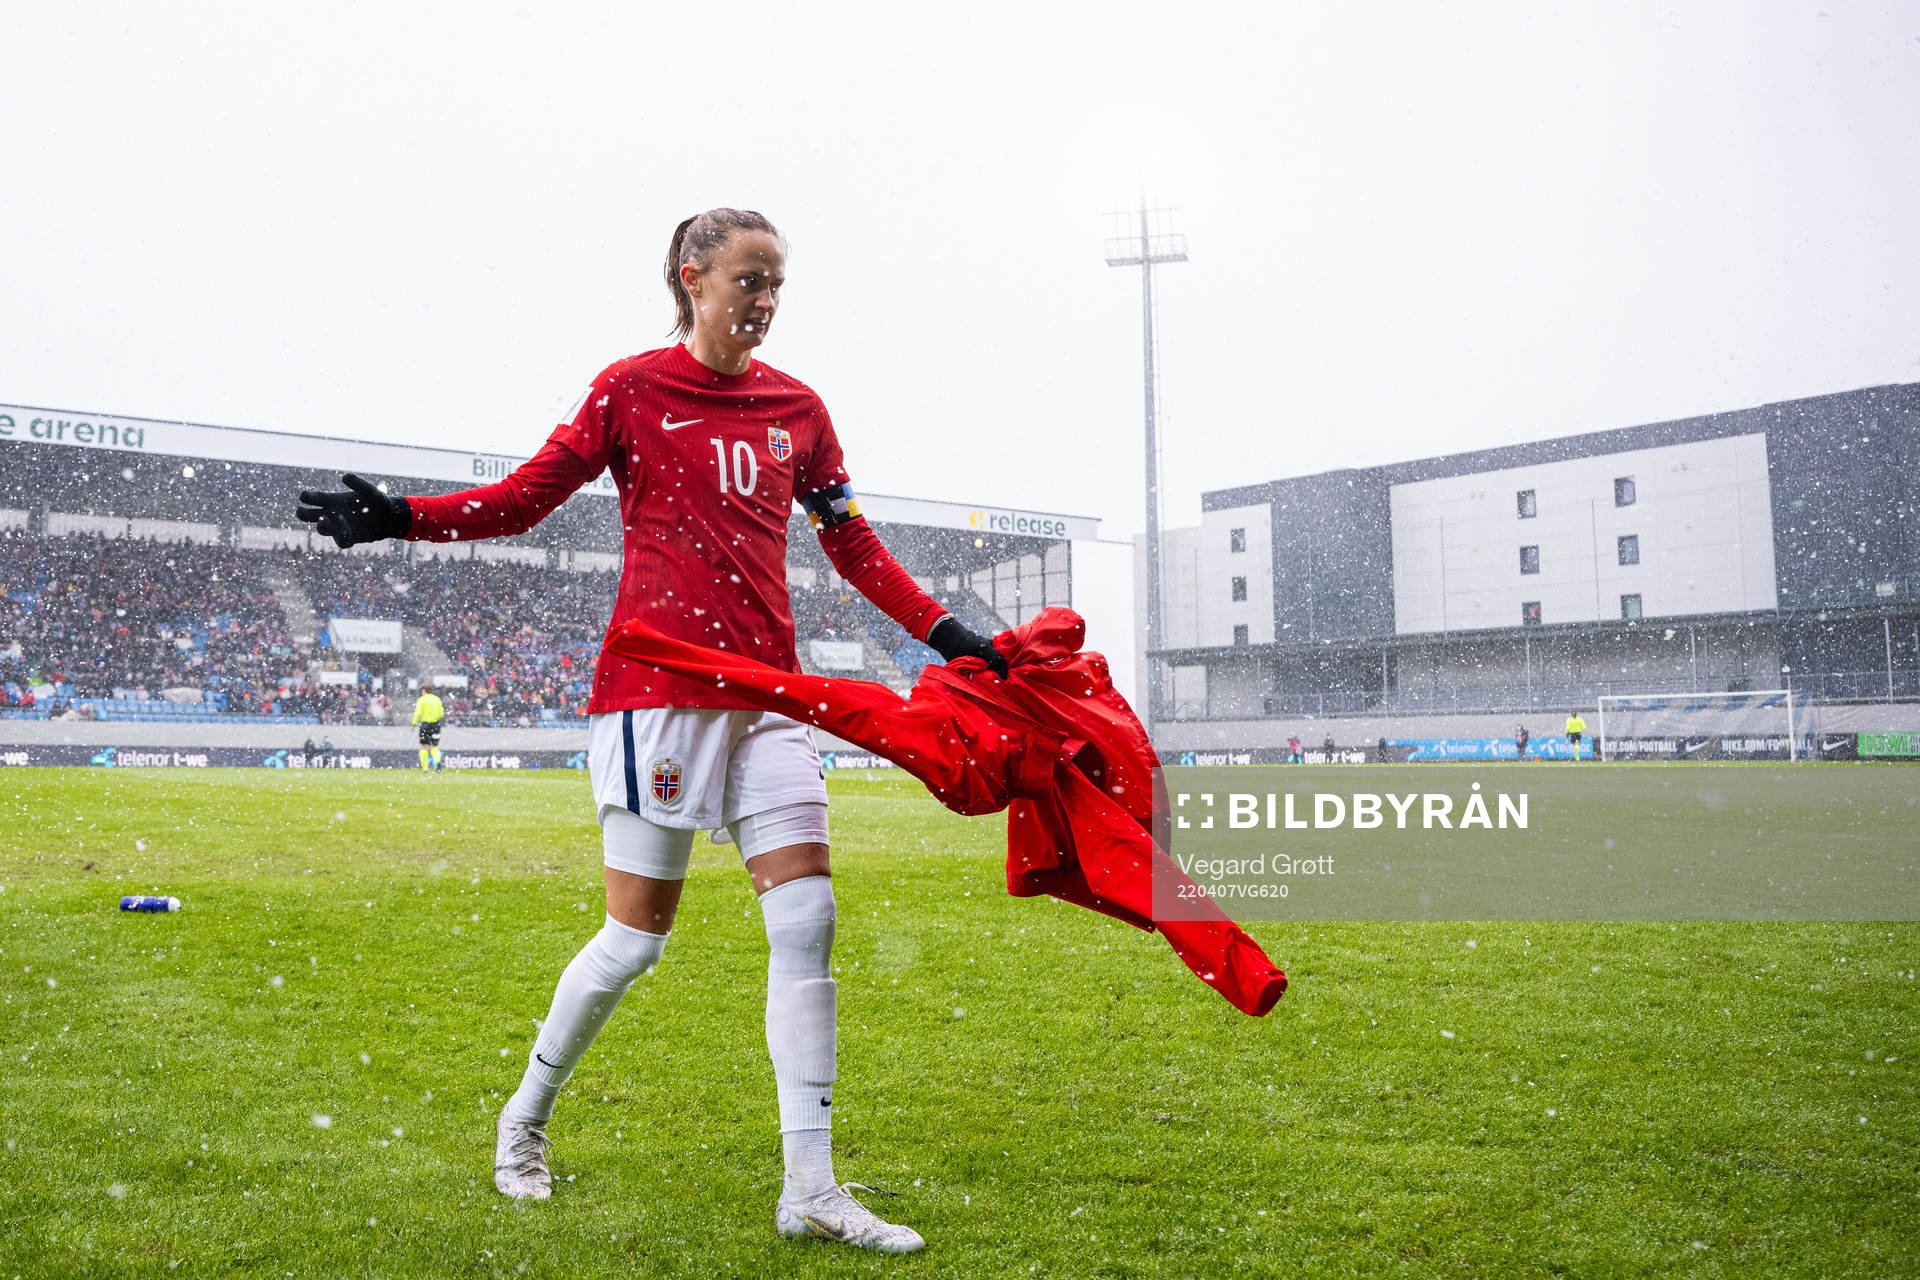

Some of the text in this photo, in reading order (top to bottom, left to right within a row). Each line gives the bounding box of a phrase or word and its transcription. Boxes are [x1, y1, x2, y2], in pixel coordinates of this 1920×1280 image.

[30, 417, 144, 448] arena
[710, 438, 757, 496] 10
[990, 512, 1065, 536] release
[1556, 742, 1590, 754] teleor
[1722, 739, 1812, 752] NIKE.COM/FOOTALL
[1866, 734, 1907, 753] KIWI
[0, 752, 29, 765] -we
[117, 750, 171, 767] telenor
[287, 753, 337, 768] telnr
[444, 755, 488, 769] telenor
[835, 755, 869, 768] telenor
[1196, 753, 1226, 766] telenor
